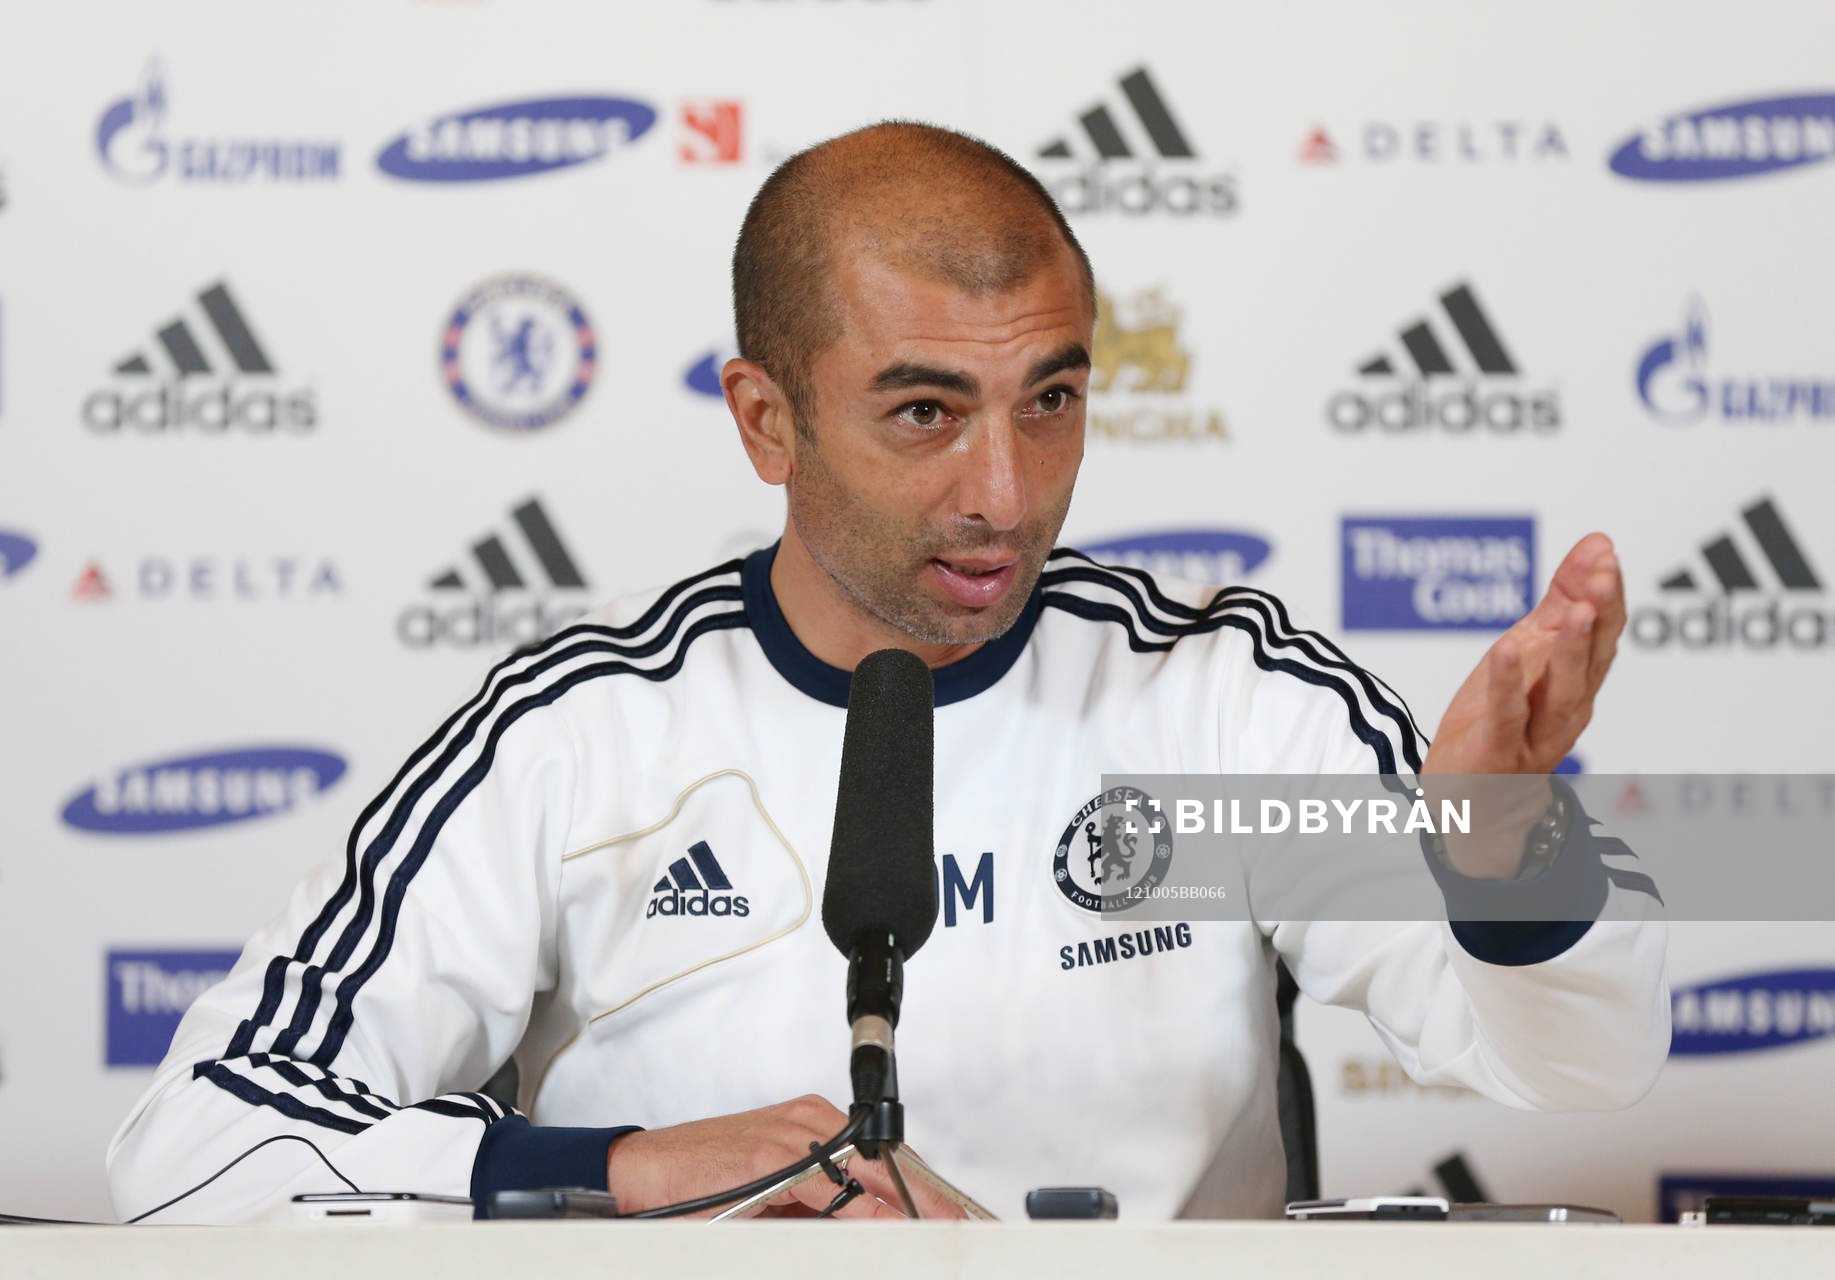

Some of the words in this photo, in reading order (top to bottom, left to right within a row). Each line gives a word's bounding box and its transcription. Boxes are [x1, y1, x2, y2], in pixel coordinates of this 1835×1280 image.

[402, 114, 631, 164] SAMSUNG
[1364, 123, 1570, 162] DELTA
[1640, 112, 1835, 162] SAMSUN
[1055, 158, 1241, 217] didas
[82, 376, 318, 434] adidas
[1326, 374, 1563, 436] adidas
[1719, 377, 1835, 423] GAZPR
[1087, 408, 1232, 445] NGHA
[1350, 524, 1529, 581] Thomas
[137, 560, 344, 599] DELTA
[1412, 566, 1528, 625] Cook
[396, 596, 590, 651] adid
[1630, 595, 1835, 652] adida
[93, 766, 323, 816] SAMSUNG
[1677, 774, 1835, 818] DELT
[646, 888, 750, 919] adidas
[935, 852, 995, 927] M
[1060, 922, 1193, 970] SAMSUNG
[1674, 987, 1835, 1038] AMSUN
